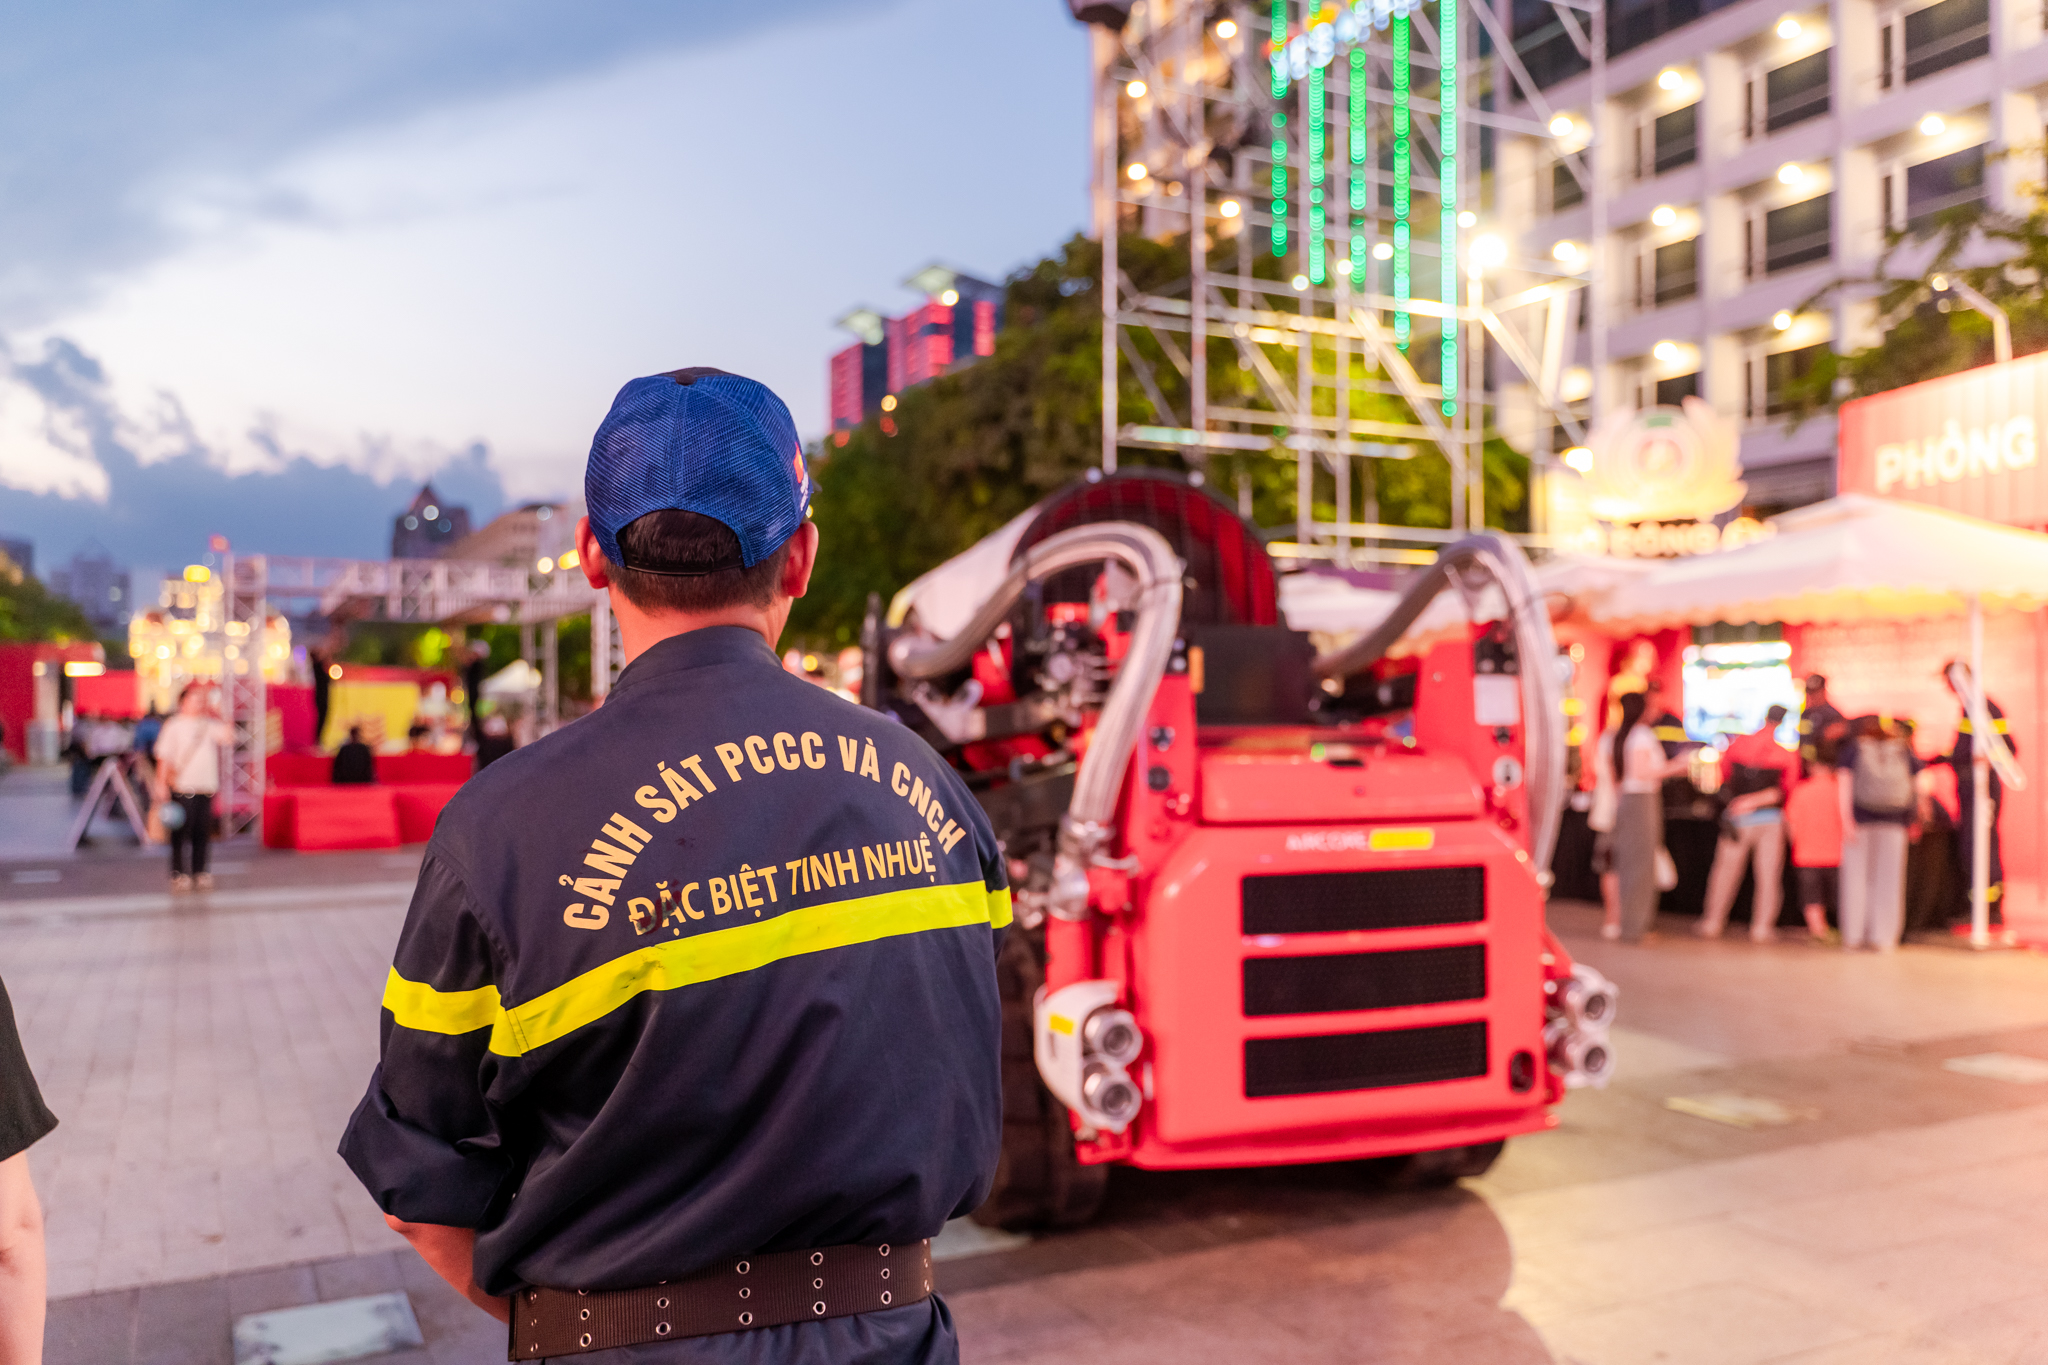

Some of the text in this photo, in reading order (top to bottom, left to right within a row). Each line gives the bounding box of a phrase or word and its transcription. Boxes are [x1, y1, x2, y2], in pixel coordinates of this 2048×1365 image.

[558, 731, 967, 931] CẢNH SÁT PCCC VÀ CNCH
[627, 831, 937, 937] ĐẶC BIỆT TINH NHUỆ
